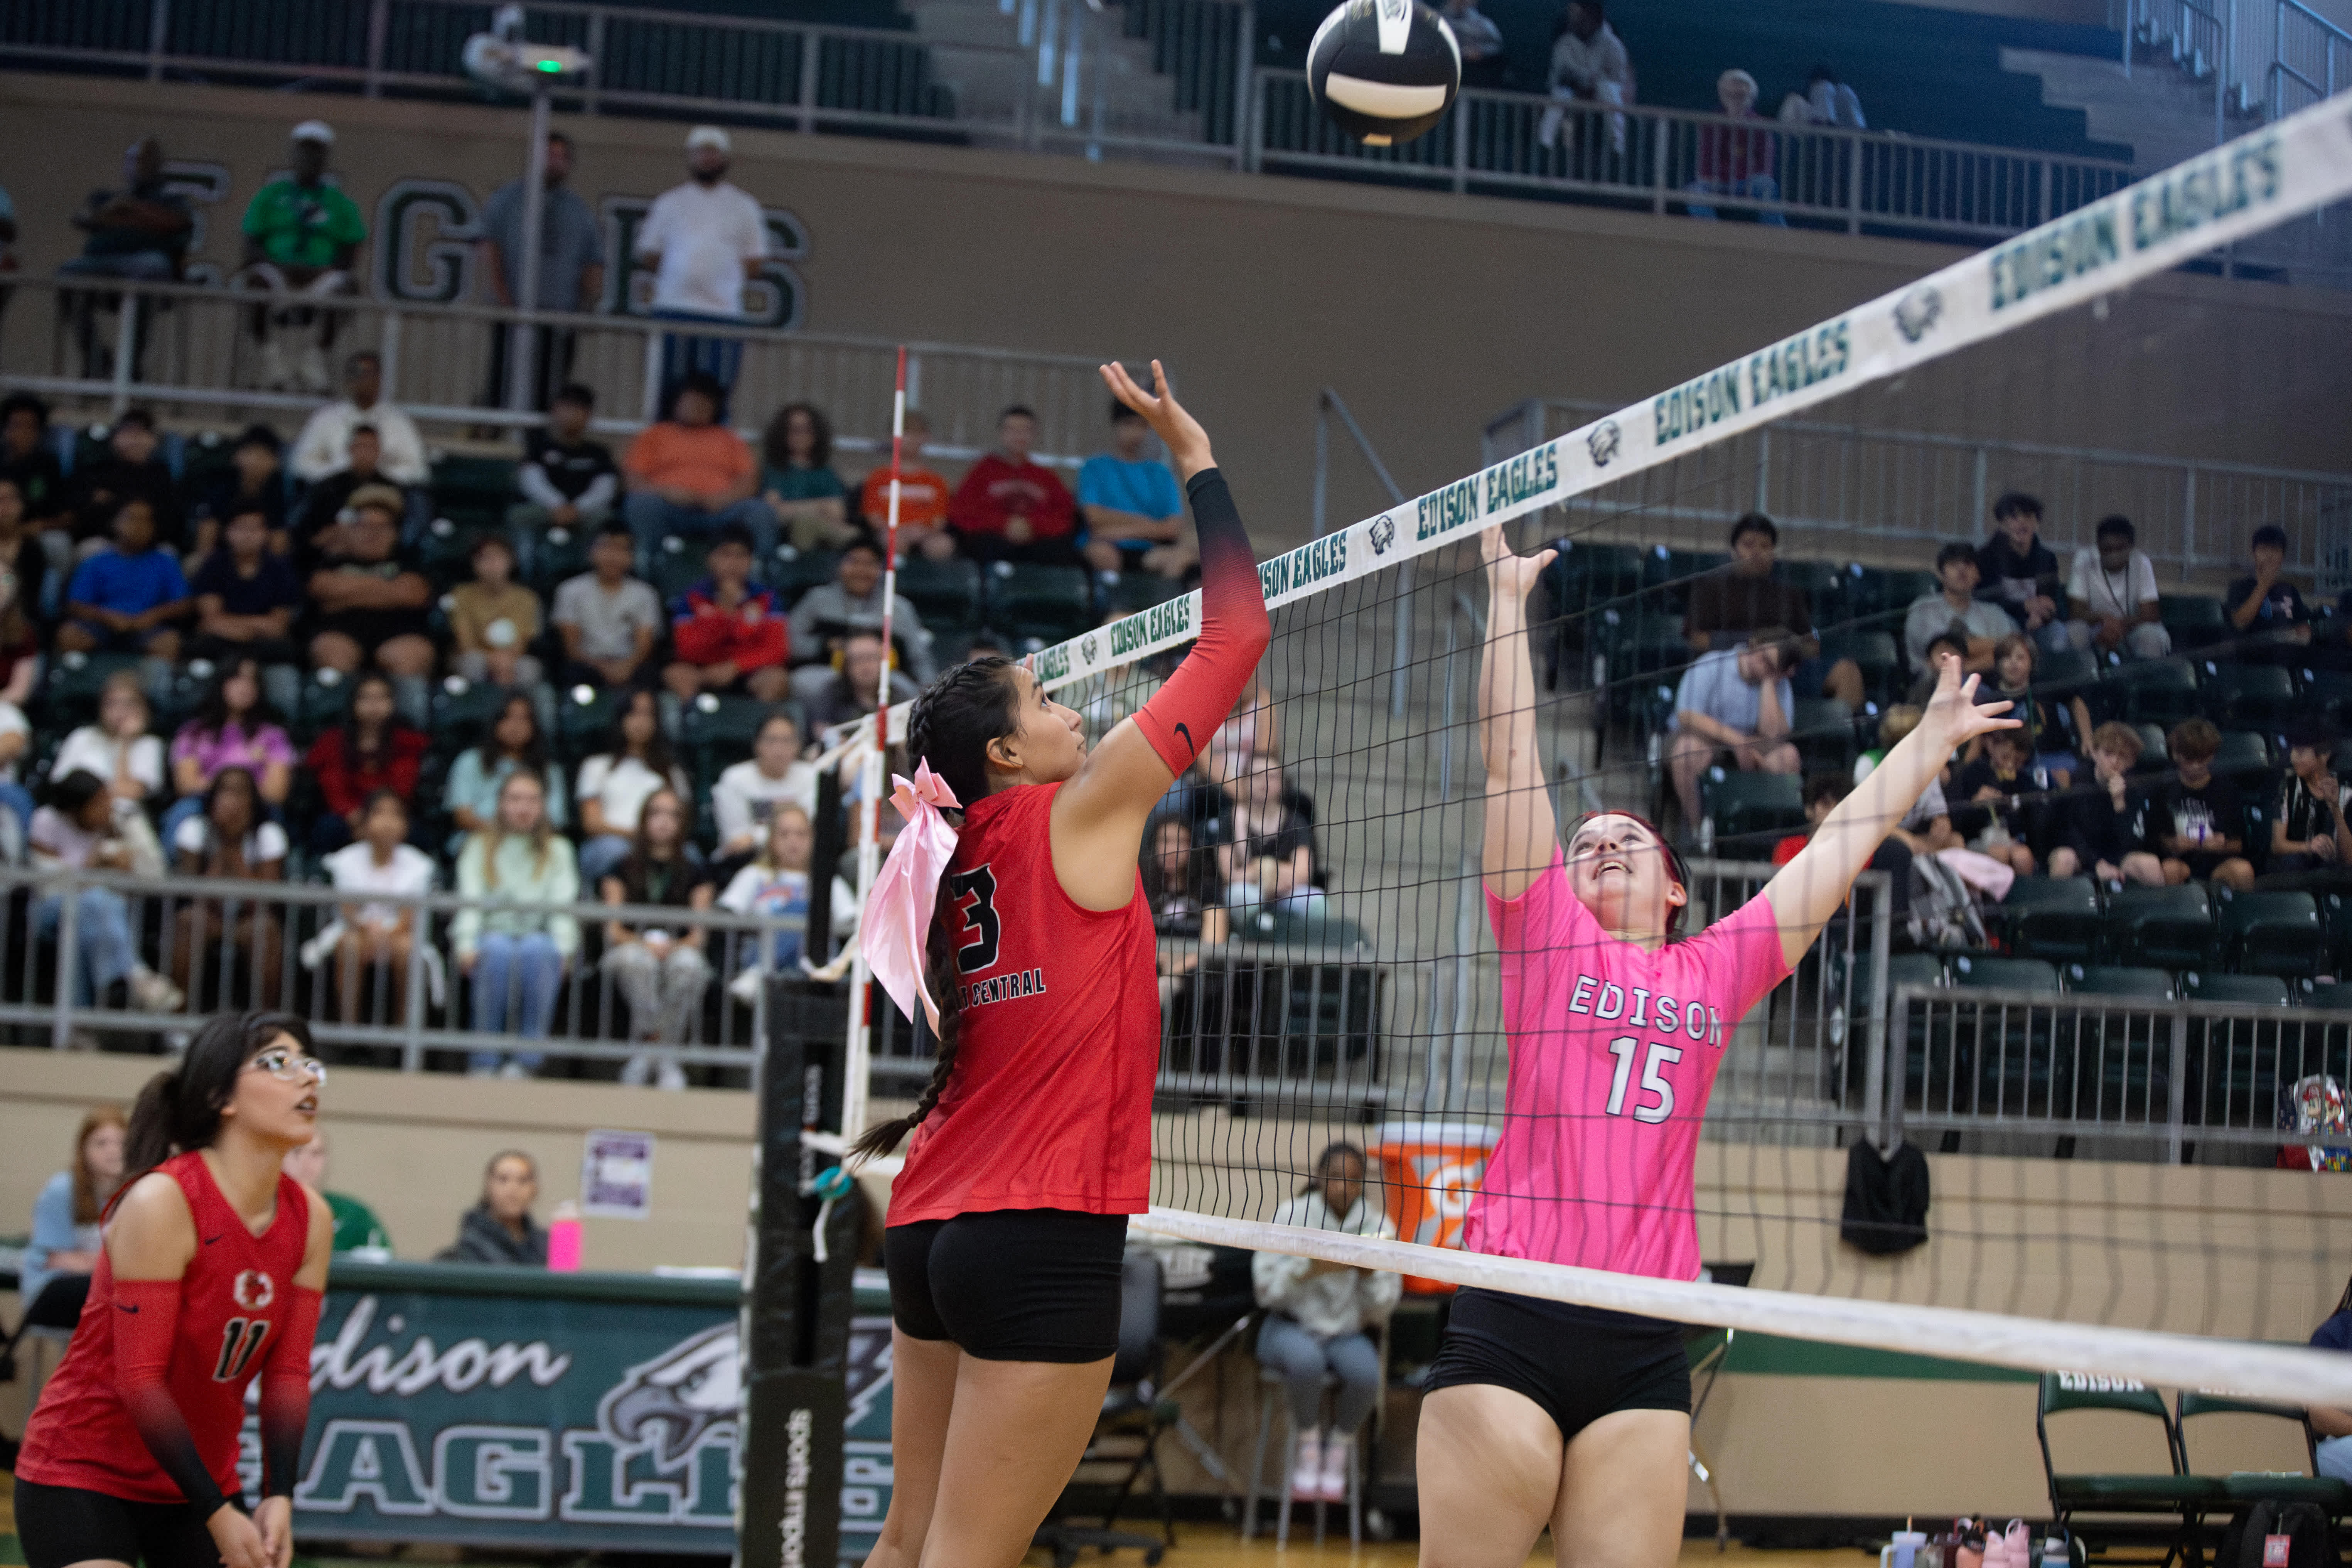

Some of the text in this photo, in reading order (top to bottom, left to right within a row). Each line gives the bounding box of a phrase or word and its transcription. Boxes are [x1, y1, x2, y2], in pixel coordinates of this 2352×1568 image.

[1654, 320, 1848, 446] EDISON EAGLES
[1417, 443, 1558, 541] EDISON EAGLES
[1292, 530, 1348, 589] EAGLES
[1110, 594, 1191, 657] EDISON EAGLES
[951, 862, 1001, 975] 3
[971, 968, 1046, 1007] CENTRAL
[1568, 974, 1723, 1049] EDISON
[1605, 1035, 1684, 1125] 15
[212, 1317, 272, 1380] 11
[309, 1294, 571, 1396] dison
